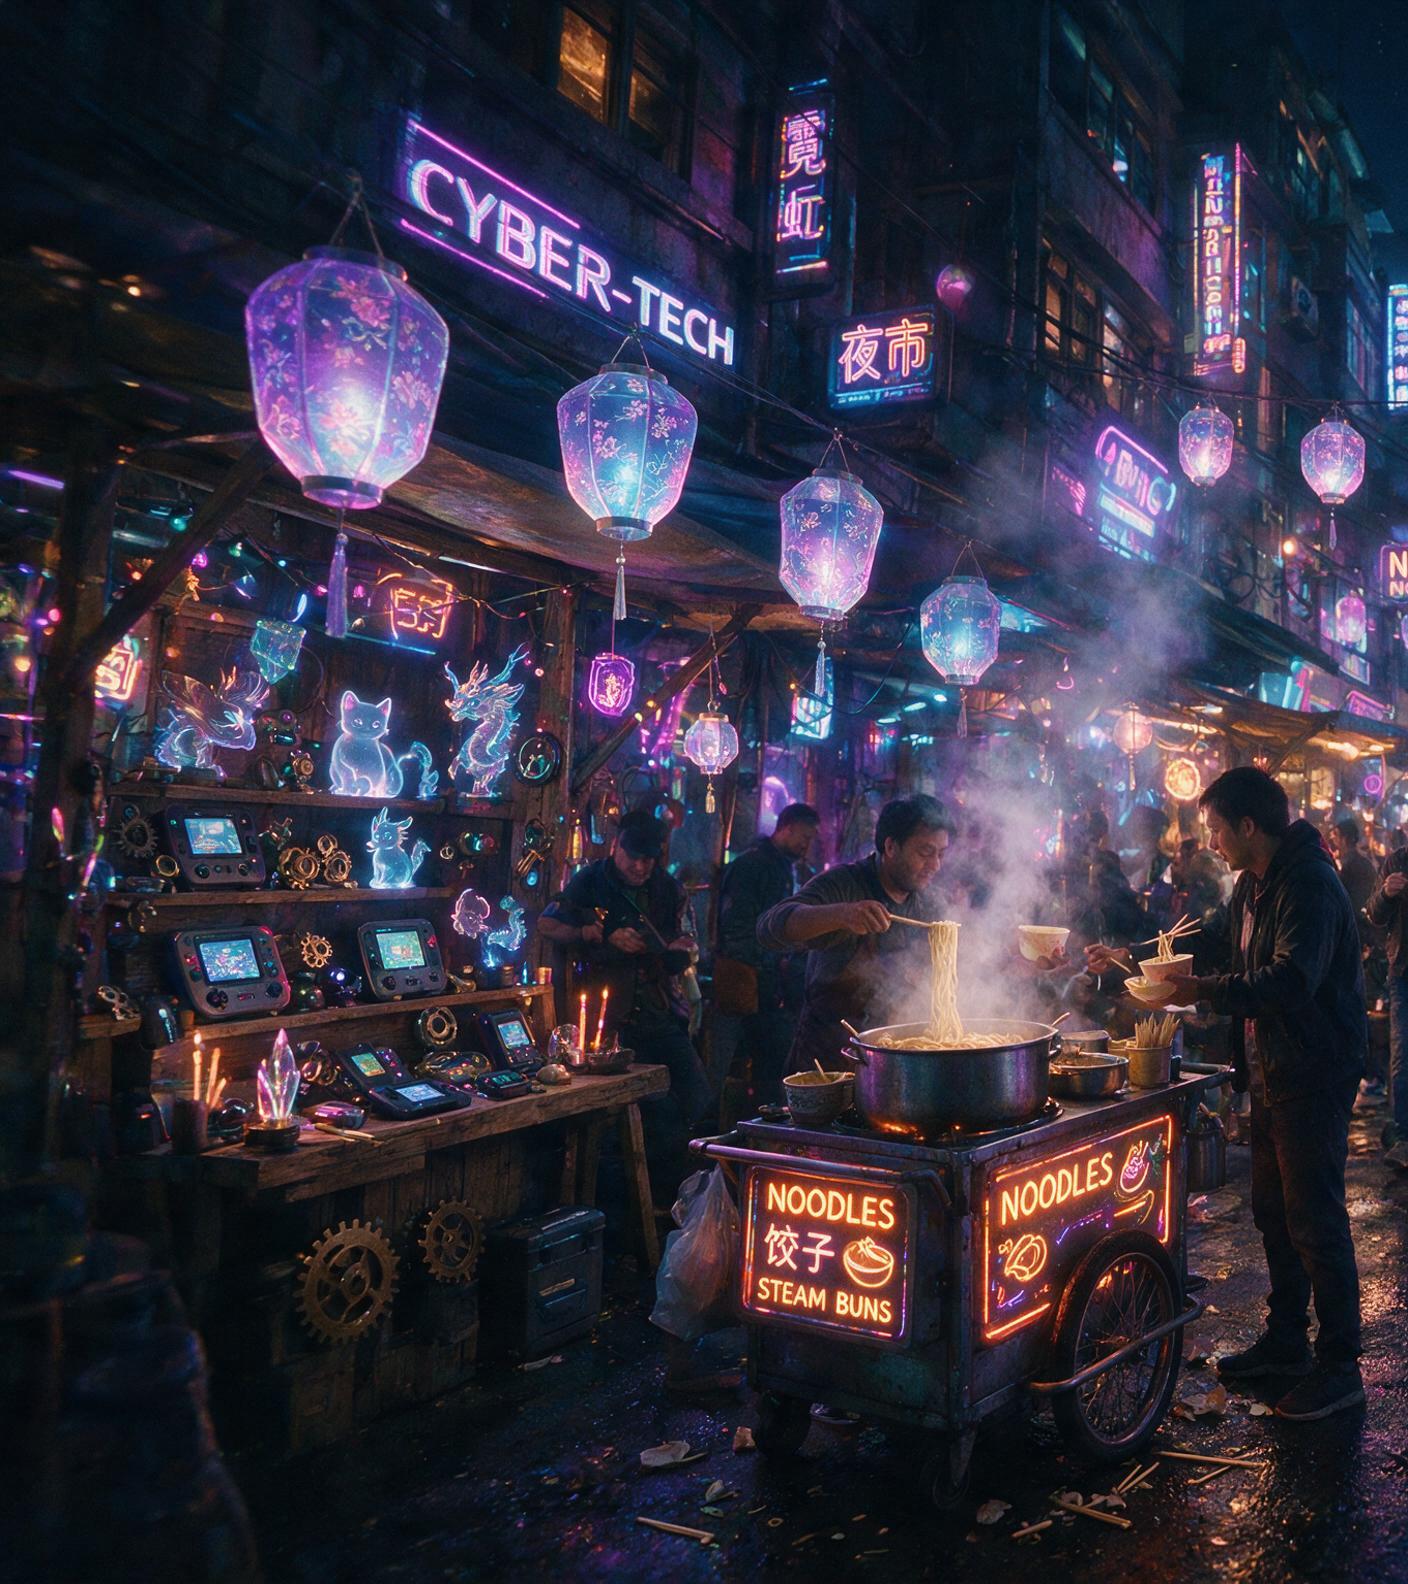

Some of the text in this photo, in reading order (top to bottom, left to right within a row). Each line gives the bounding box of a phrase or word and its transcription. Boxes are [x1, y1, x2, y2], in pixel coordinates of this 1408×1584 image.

[407, 159, 735, 366] CYBER-TECH
[838, 318, 928, 384] 夜市
[767, 1183, 895, 1230] NOODLES
[1001, 1152, 1114, 1226] NOODLES
[764, 1223, 835, 1274] 饺子
[757, 1278, 892, 1323] STEAM BUNS
